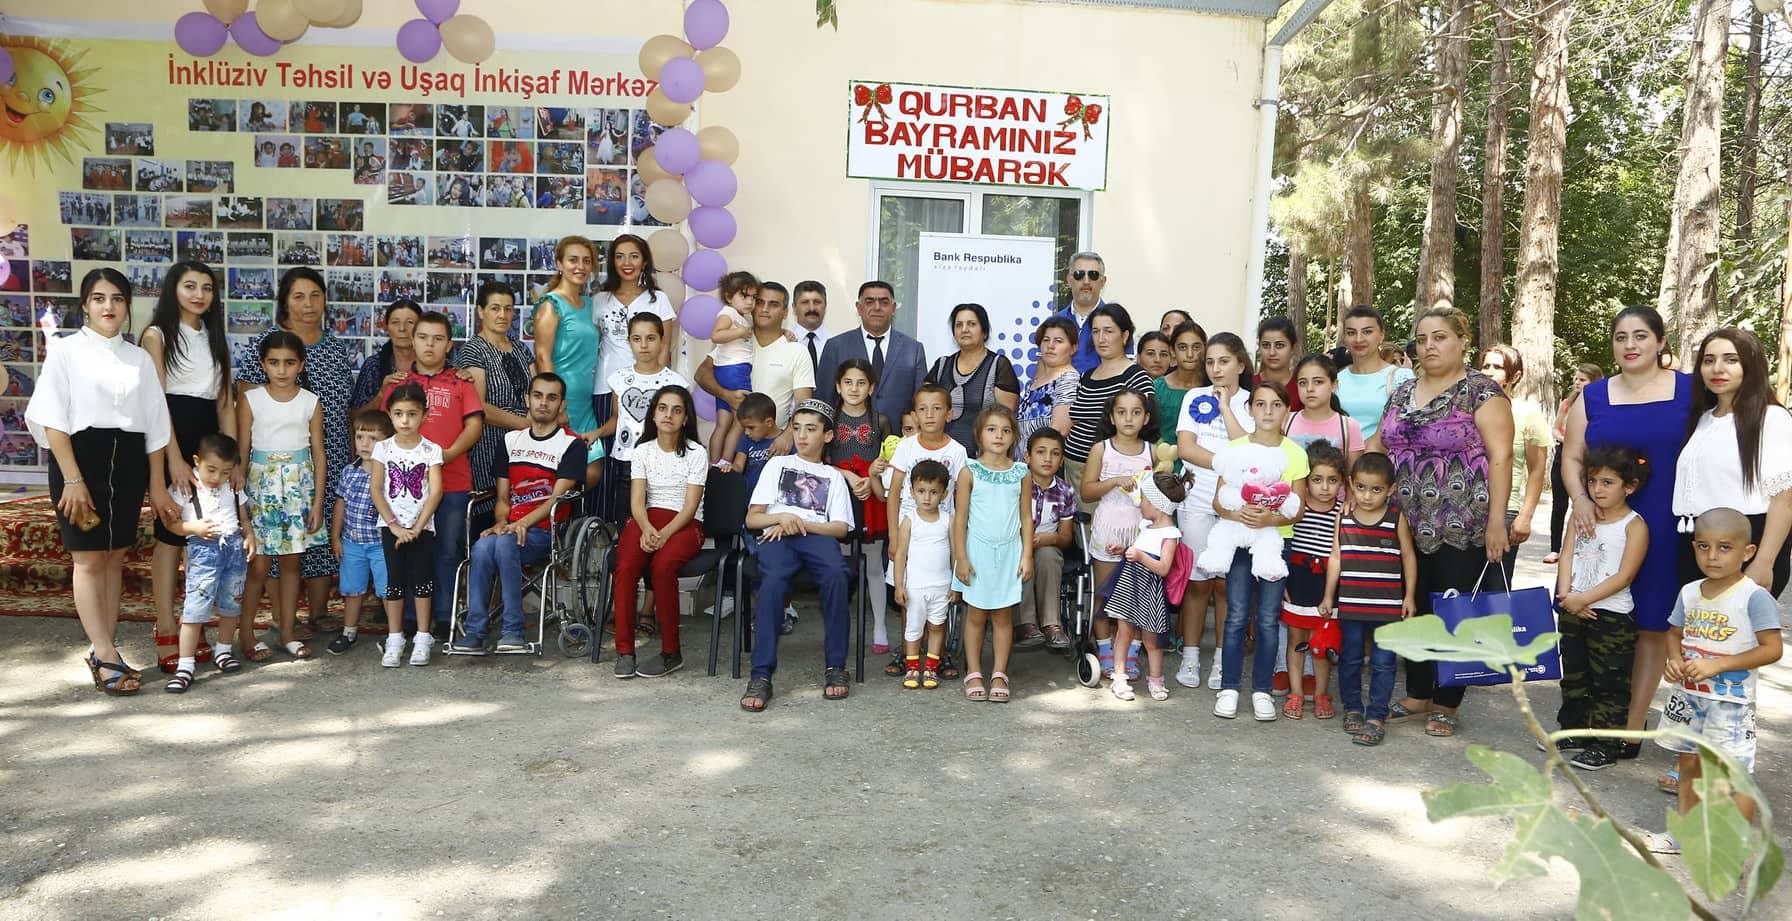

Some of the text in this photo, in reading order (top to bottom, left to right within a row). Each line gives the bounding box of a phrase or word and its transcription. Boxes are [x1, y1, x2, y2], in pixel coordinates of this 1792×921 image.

[168, 53, 267, 87] İnklüziv
[275, 62, 352, 89] Təhsil
[362, 70, 391, 90] və
[400, 65, 465, 98] Uşaq
[474, 62, 560, 99] İnkişaf
[900, 90, 1047, 123] QURBAN
[865, 120, 1077, 155] BAYRAMINIZ
[897, 148, 1071, 187] MÜBARƏK
[933, 251, 1022, 265] Bank Respublika
[1668, 695, 1685, 716] 52
